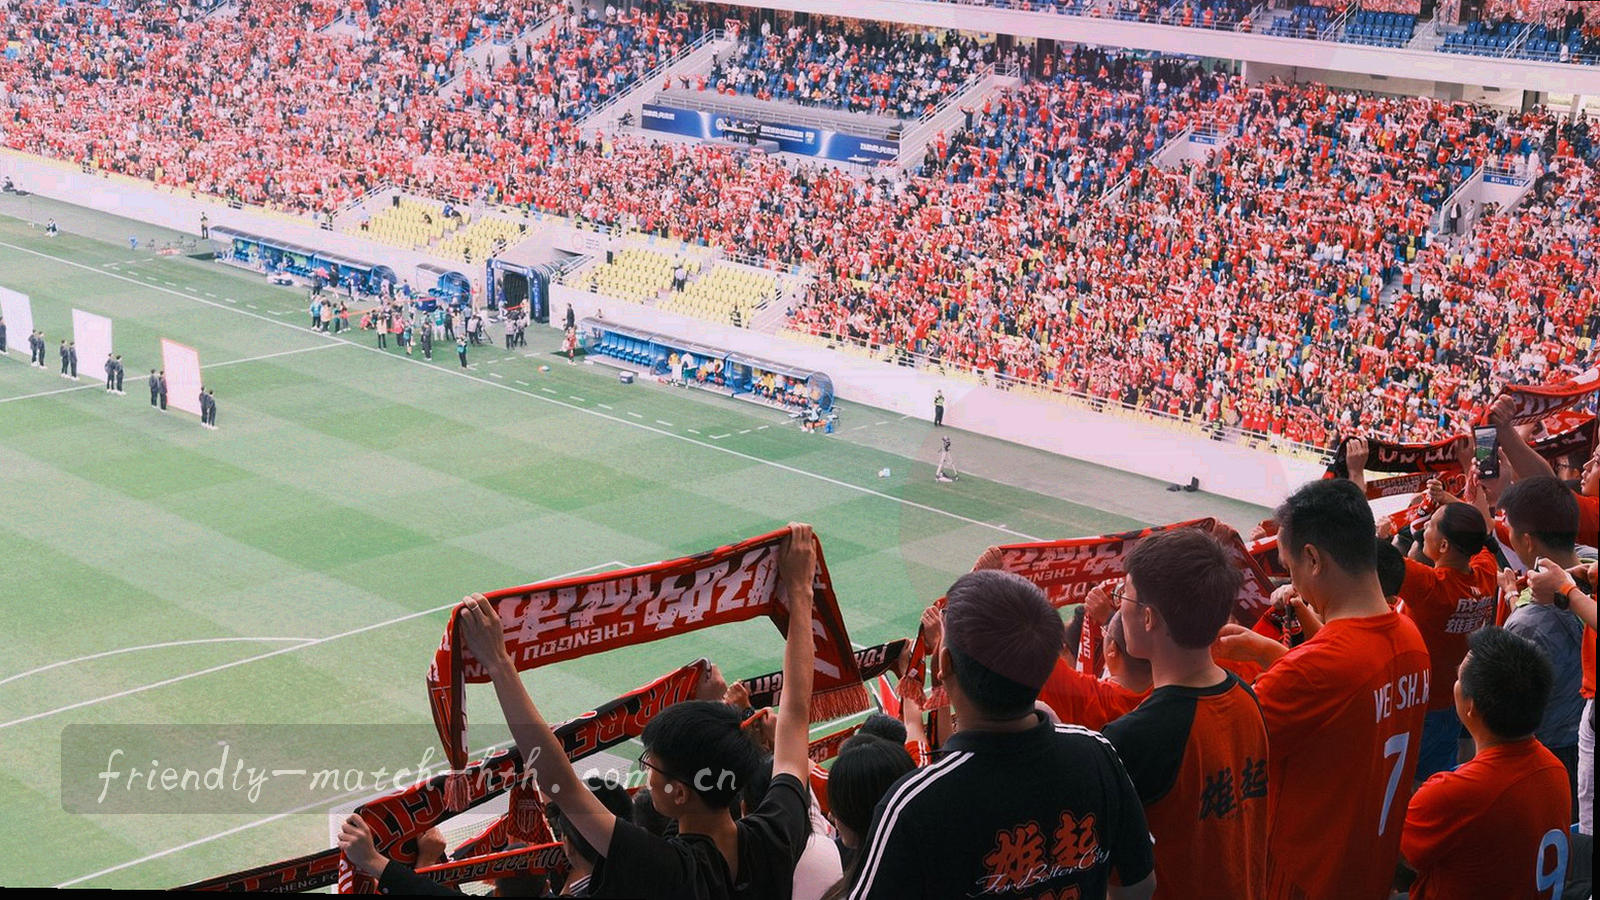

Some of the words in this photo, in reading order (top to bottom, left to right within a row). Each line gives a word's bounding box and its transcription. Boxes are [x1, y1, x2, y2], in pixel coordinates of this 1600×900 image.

[522, 621, 636, 660] CHENGDU
[1378, 731, 1410, 837] 7
[1535, 828, 1569, 899] 9
